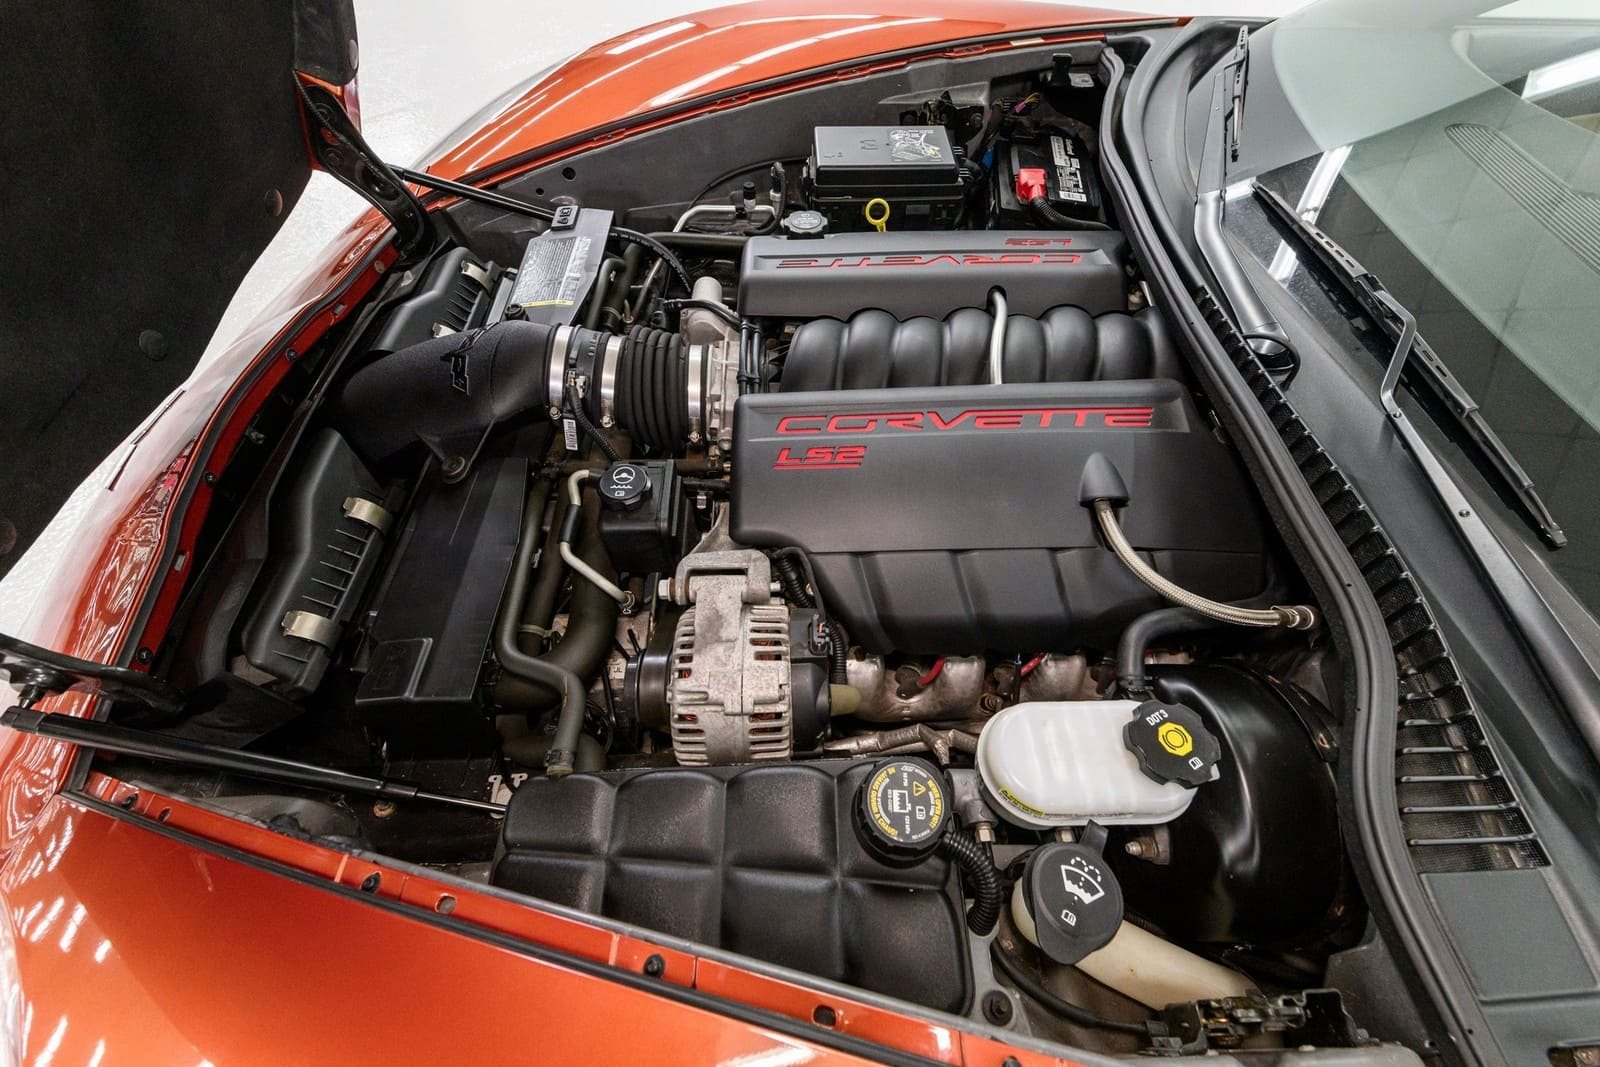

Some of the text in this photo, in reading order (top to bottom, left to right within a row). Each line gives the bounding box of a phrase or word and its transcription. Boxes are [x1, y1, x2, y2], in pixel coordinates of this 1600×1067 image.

[1005, 238, 1073, 247] LS2
[776, 254, 1082, 268] CORVETTE
[776, 407, 1154, 435] CORVETTE
[774, 445, 867, 468] LS2
